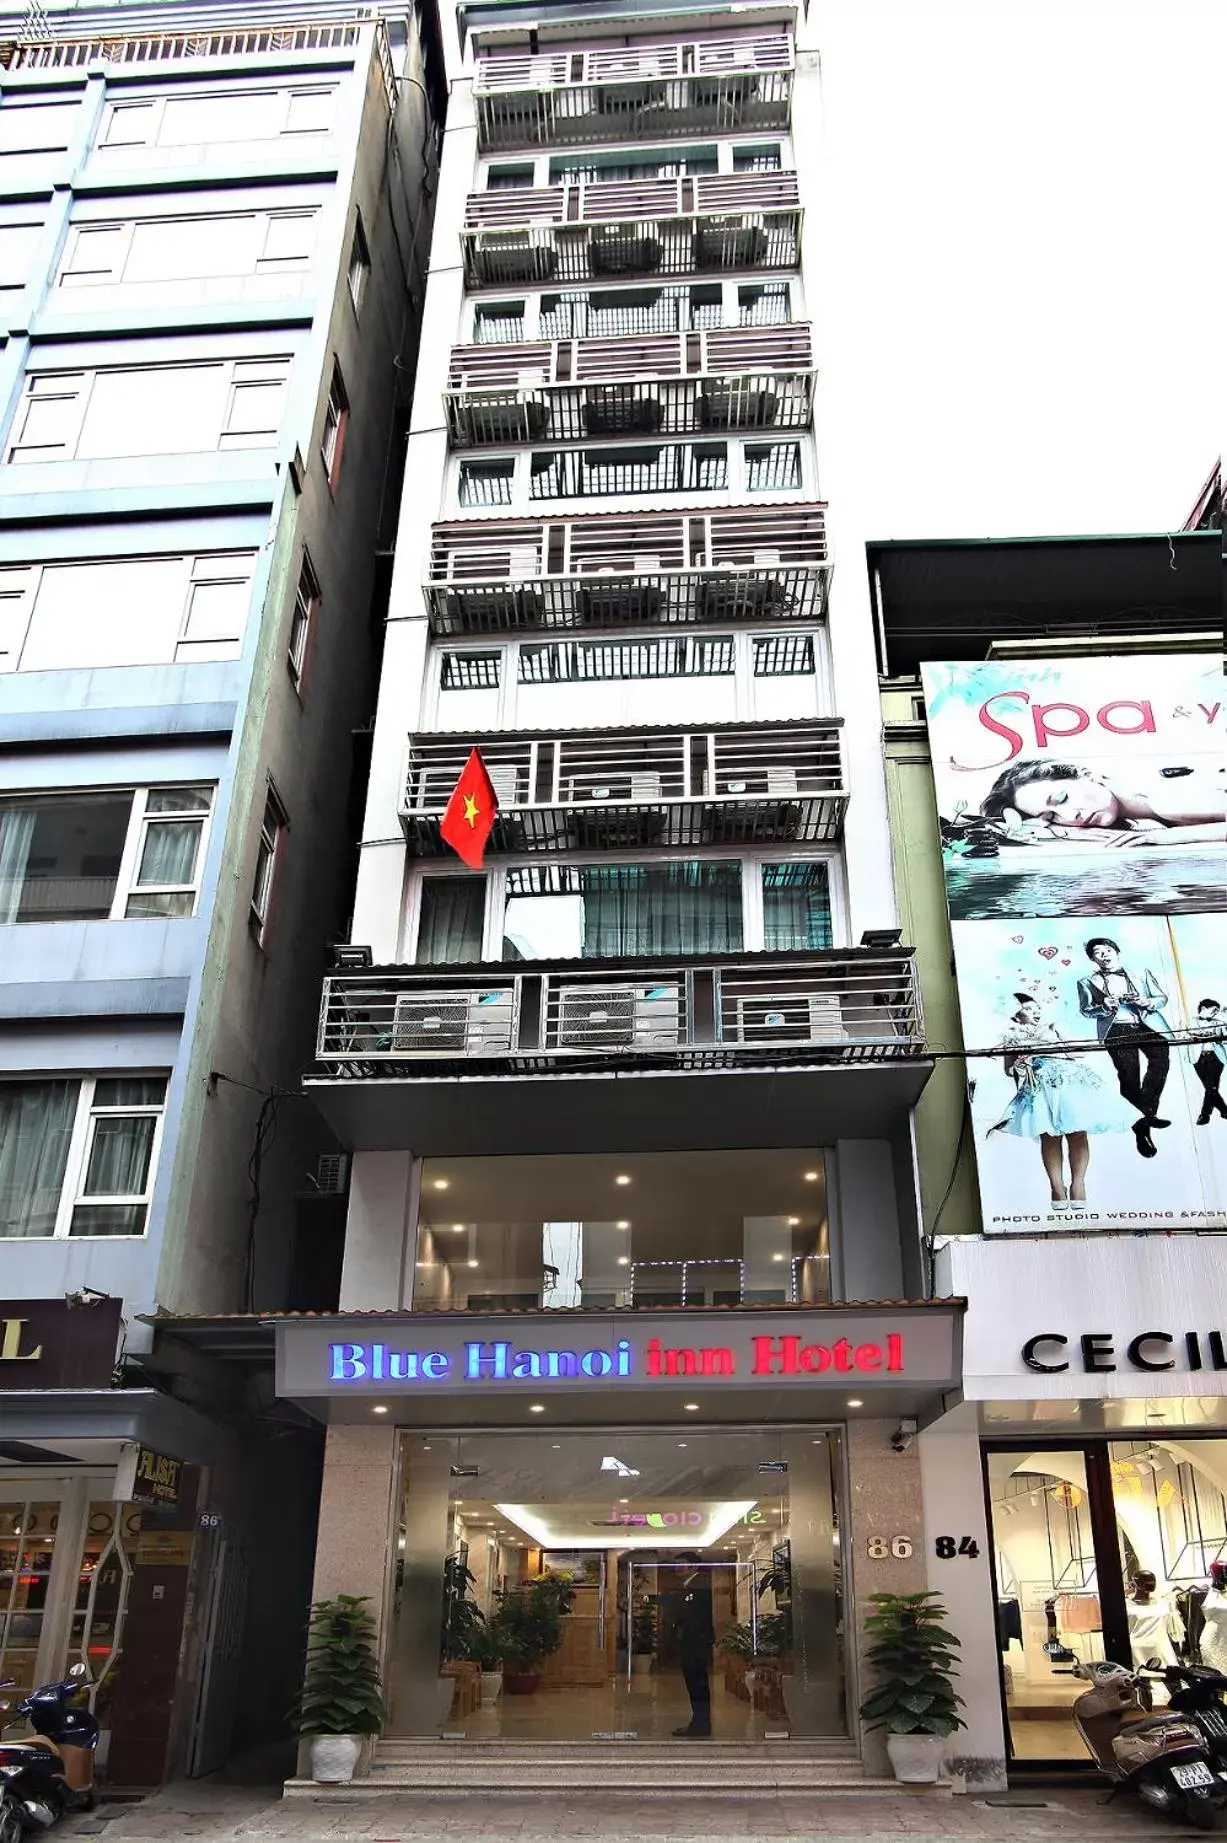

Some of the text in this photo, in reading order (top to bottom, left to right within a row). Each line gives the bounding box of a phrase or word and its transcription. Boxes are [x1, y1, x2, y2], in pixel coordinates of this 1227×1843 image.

[950, 691, 1157, 772] Spa
[1172, 705, 1192, 719] &
[992, 1215, 1041, 1223] PHOTO
[1047, 1213, 1099, 1221] STUDIO
[1106, 1211, 1174, 1219] WEDDING
[0, 1318, 42, 1360] L
[1021, 1331, 1227, 1373] CECIL
[328, 1333, 904, 1380] Blue Hanoi inn Hotel
[200, 1514, 219, 1527] 86
[866, 1535, 914, 1559] 86
[935, 1535, 980, 1559] 84
